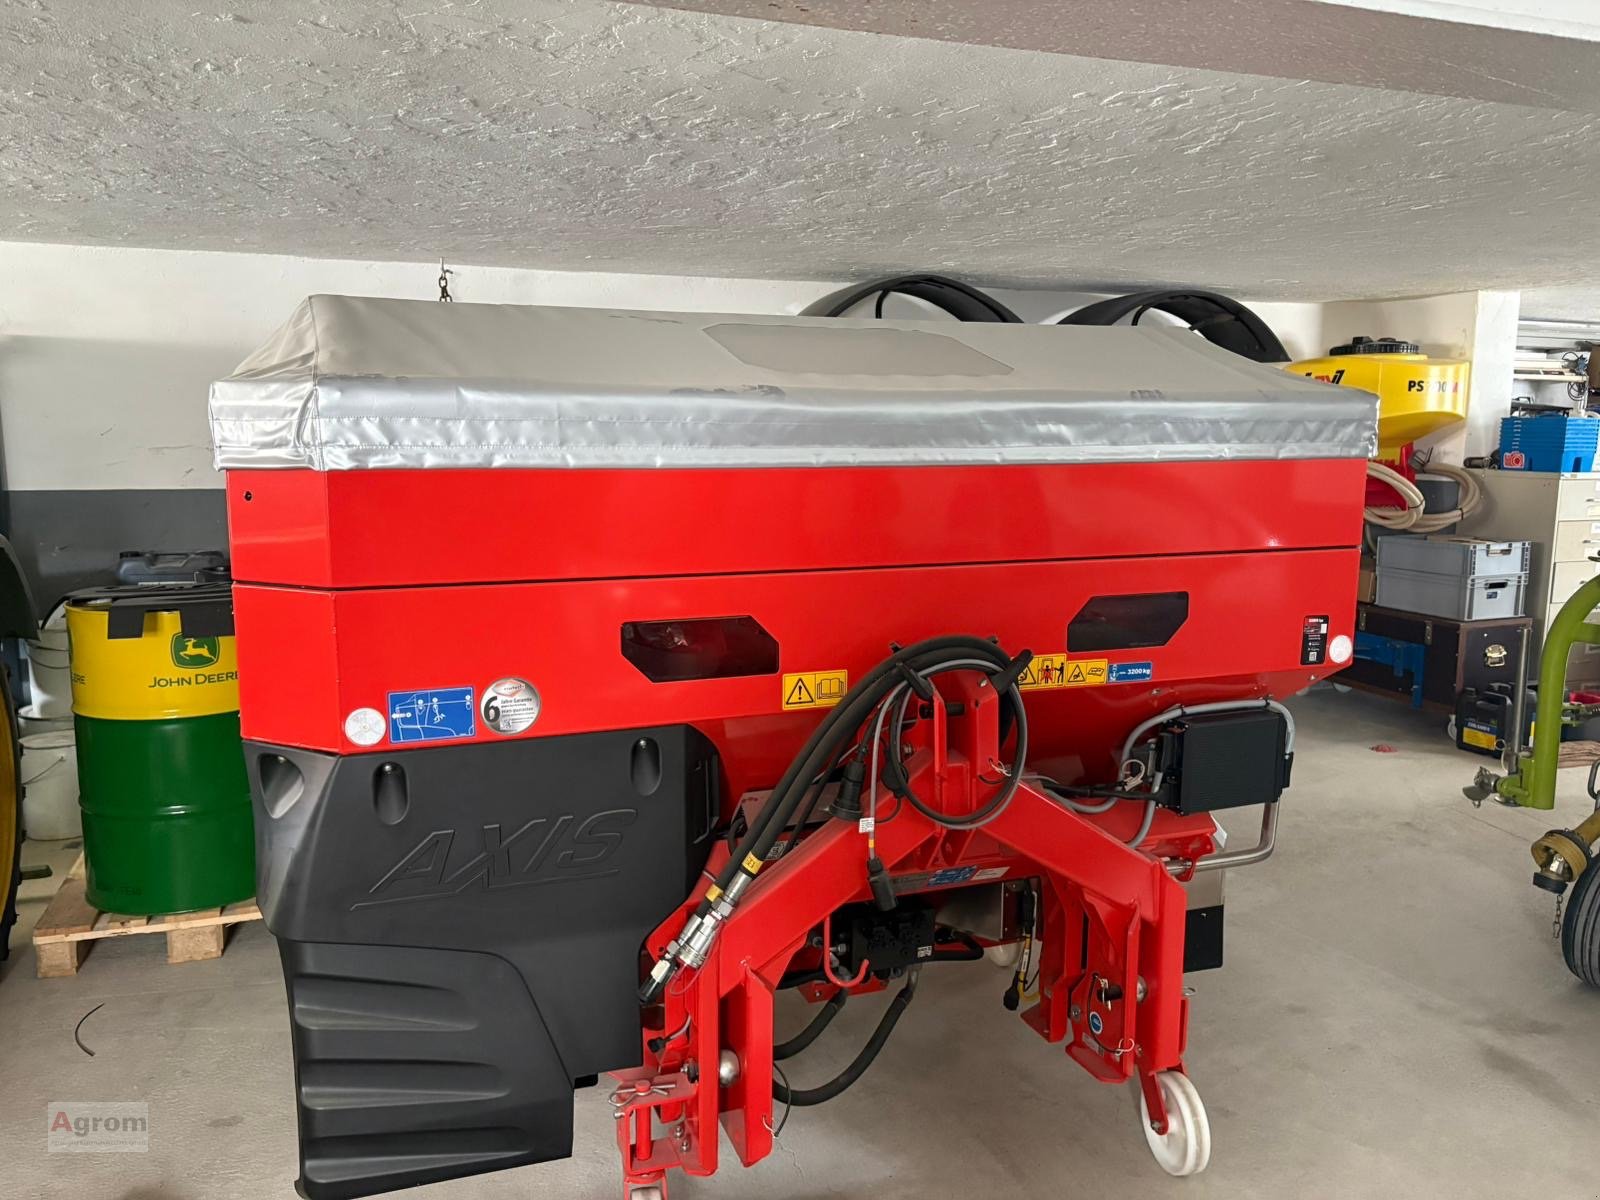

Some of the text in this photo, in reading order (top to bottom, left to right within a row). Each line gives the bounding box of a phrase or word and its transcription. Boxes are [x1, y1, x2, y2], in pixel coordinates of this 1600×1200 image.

[1408, 380, 1424, 392] PS
[148, 676, 192, 688] JOHN
[483, 695, 501, 723] 6
[362, 808, 638, 898] AXIS
